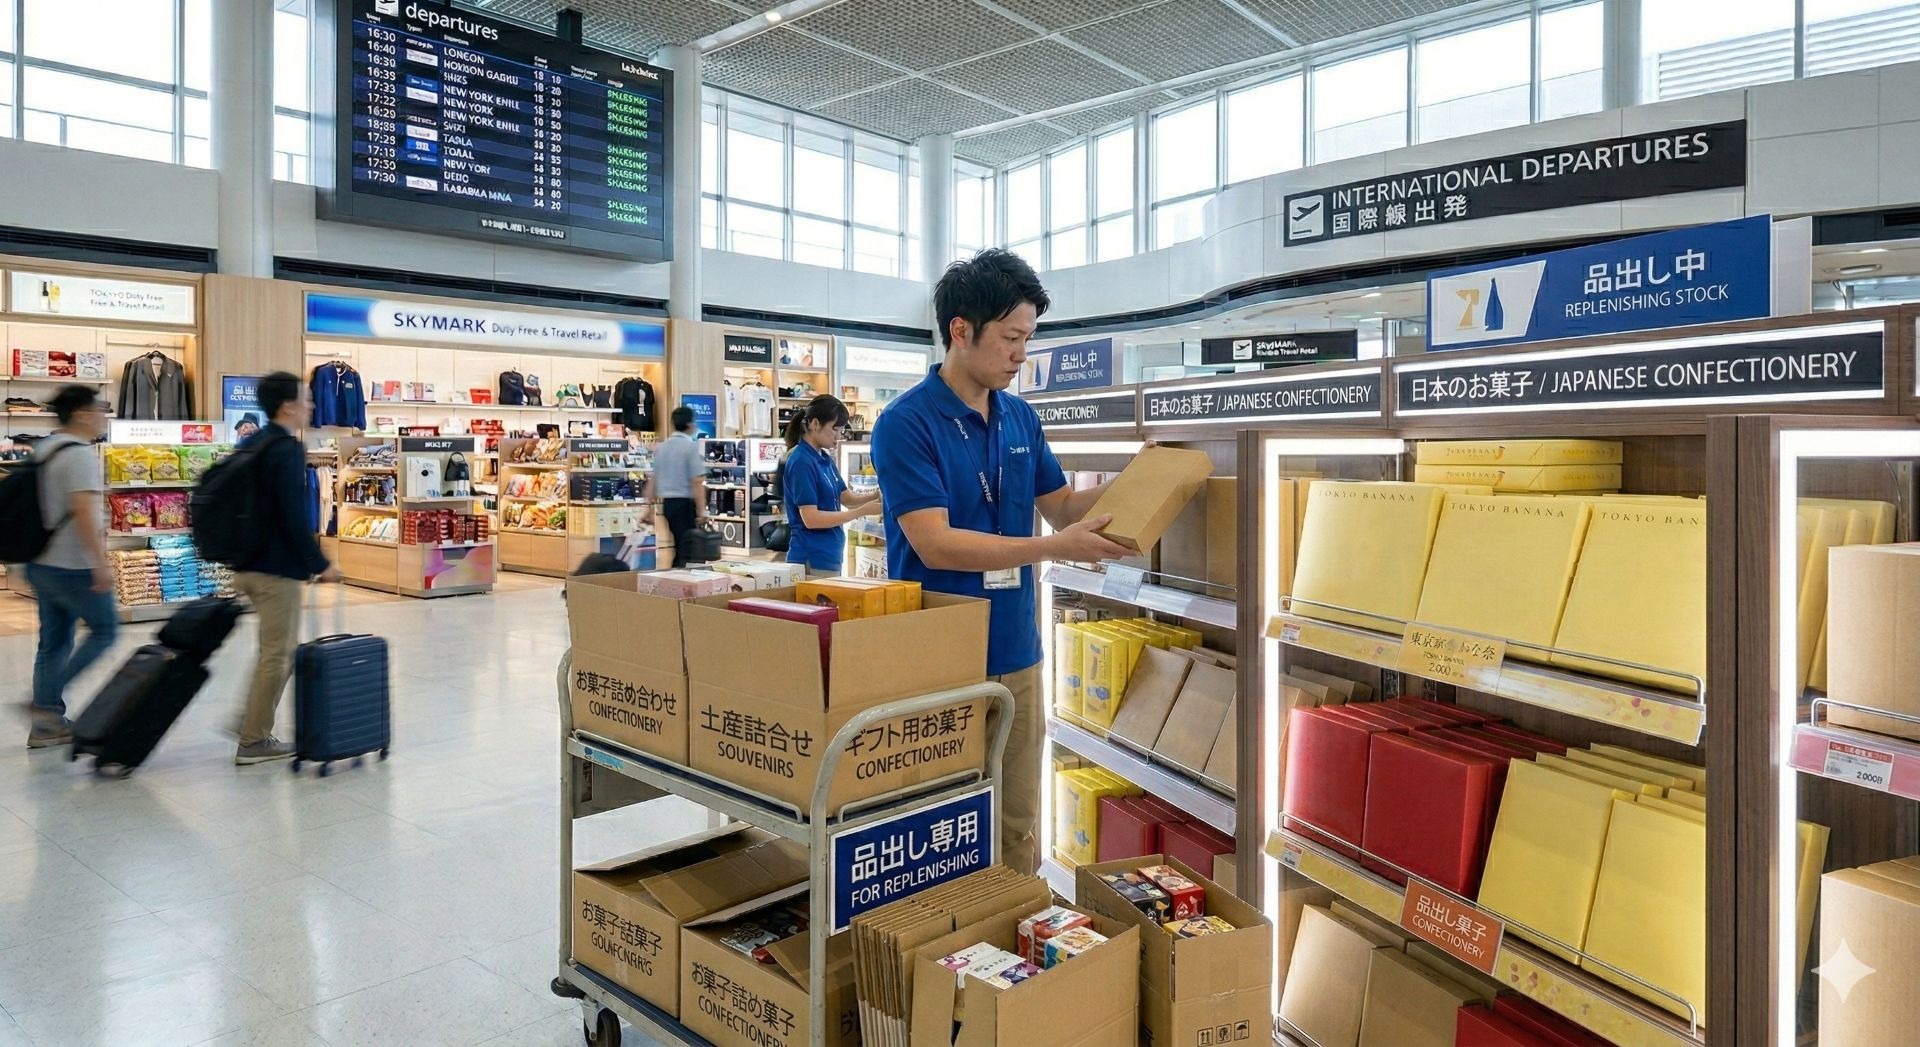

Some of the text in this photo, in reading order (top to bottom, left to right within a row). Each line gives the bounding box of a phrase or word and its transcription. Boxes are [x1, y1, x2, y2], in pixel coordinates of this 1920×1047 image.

[405, 2, 499, 40] departures
[367, 41, 396, 55] 16:40
[367, 28, 396, 42] 16:30
[533, 70, 544, 80] 18
[367, 53, 396, 67] 16:30
[367, 92, 396, 107] 17:22
[443, 110, 467, 122] NEW
[468, 115, 495, 128] YORK
[443, 84, 467, 98] NEW
[468, 90, 495, 104] YORK
[443, 97, 466, 109] NEW
[468, 102, 494, 116] YORK
[367, 170, 396, 183] 17:30
[443, 159, 466, 170] NEW
[1331, 132, 1709, 209] INTERNATIONAL DEPARTURES
[1332, 195, 1468, 234] 国際線出発
[1583, 248, 1706, 294] 品出し中
[1565, 284, 1729, 318] REPLENISHING STOCK
[394, 312, 608, 340] SKYMARK Duty Free & Travel Retail
[1060, 349, 1098, 371] 品出し中
[1411, 350, 1858, 402] 日本のお菓子 / JAPANESE CONFECTIONERY
[1046, 404, 1100, 421] CONFECTIONERY
[1150, 384, 1373, 417] 日本のお菓子 / JAPANESE CONFECTIONERY
[1318, 489, 1415, 502] TOKYO BANANA
[1451, 502, 1566, 518] TOKYO BANANA
[1601, 512, 1700, 526] TOKYO BAN
[576, 669, 677, 716] お菓子詰め合わせ
[588, 700, 663, 736] CONFECTIONERY
[700, 703, 814, 758] 土産詰合せ
[845, 704, 975, 757] ギフト用お菓子
[717, 740, 794, 779] SOUVENIRS
[856, 737, 965, 780] CONFECTIONERY
[851, 810, 978, 884] 品出し専用
[851, 848, 979, 909] FOR REPLENISHING
[582, 899, 663, 957] お菓子詰菓子
[1412, 915, 1486, 959] CONFECTIONERY
[1416, 894, 1487, 942] 品出し菓子
[692, 961, 796, 1037] お菓子詰め菓子
